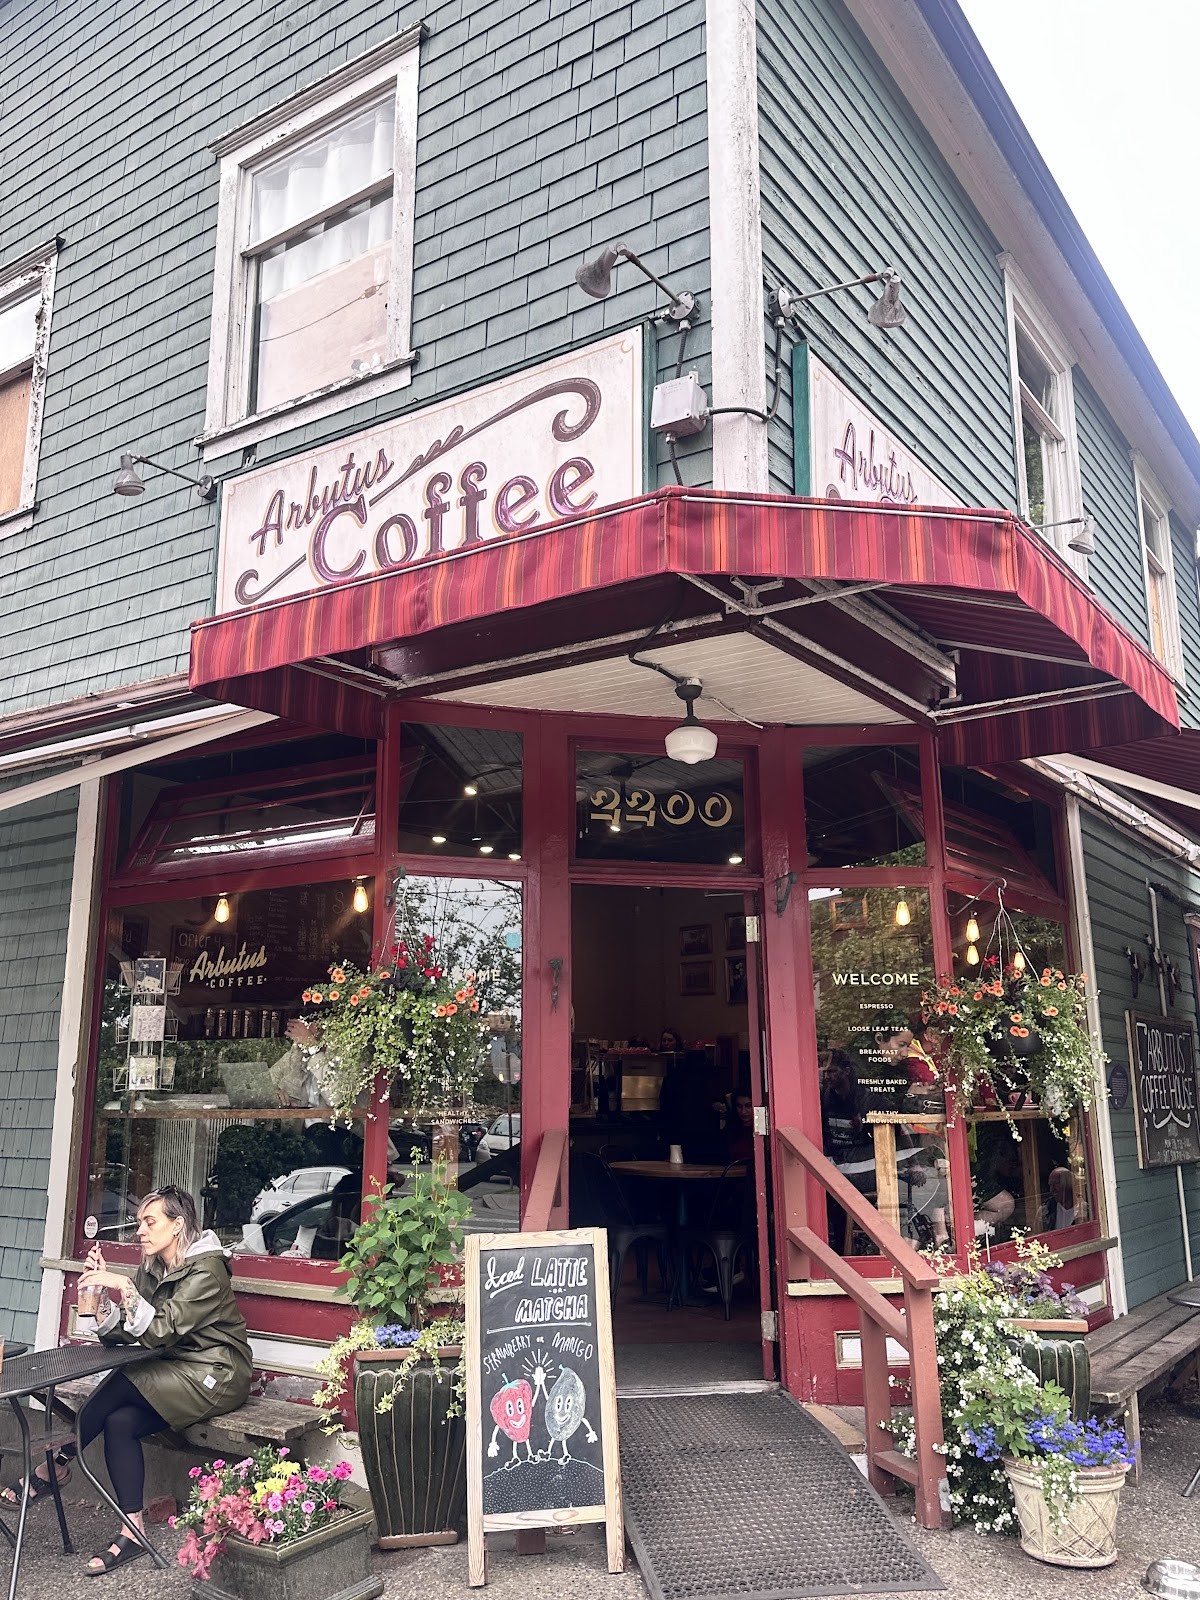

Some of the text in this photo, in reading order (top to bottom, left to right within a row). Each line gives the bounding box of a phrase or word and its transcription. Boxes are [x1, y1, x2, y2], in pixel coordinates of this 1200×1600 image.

[834, 419, 918, 504] Arbutus
[250, 447, 394, 555] Arbutus
[310, 456, 598, 583] Coffee
[590, 787, 733, 827] 2200
[189, 941, 268, 982] Arbutus
[832, 973, 919, 986] WELCOME
[1148, 1029, 1186, 1073] ARBUTUS
[1141, 1074, 1170, 1113] COFFEE
[1168, 1074, 1195, 1110] HOUSE
[485, 1256, 588, 1291] Iced LATTE
[515, 1294, 588, 1323] MATCHA
[483, 1334, 531, 1375] STRAWBERRY
[552, 1332, 594, 1362] MANGO
